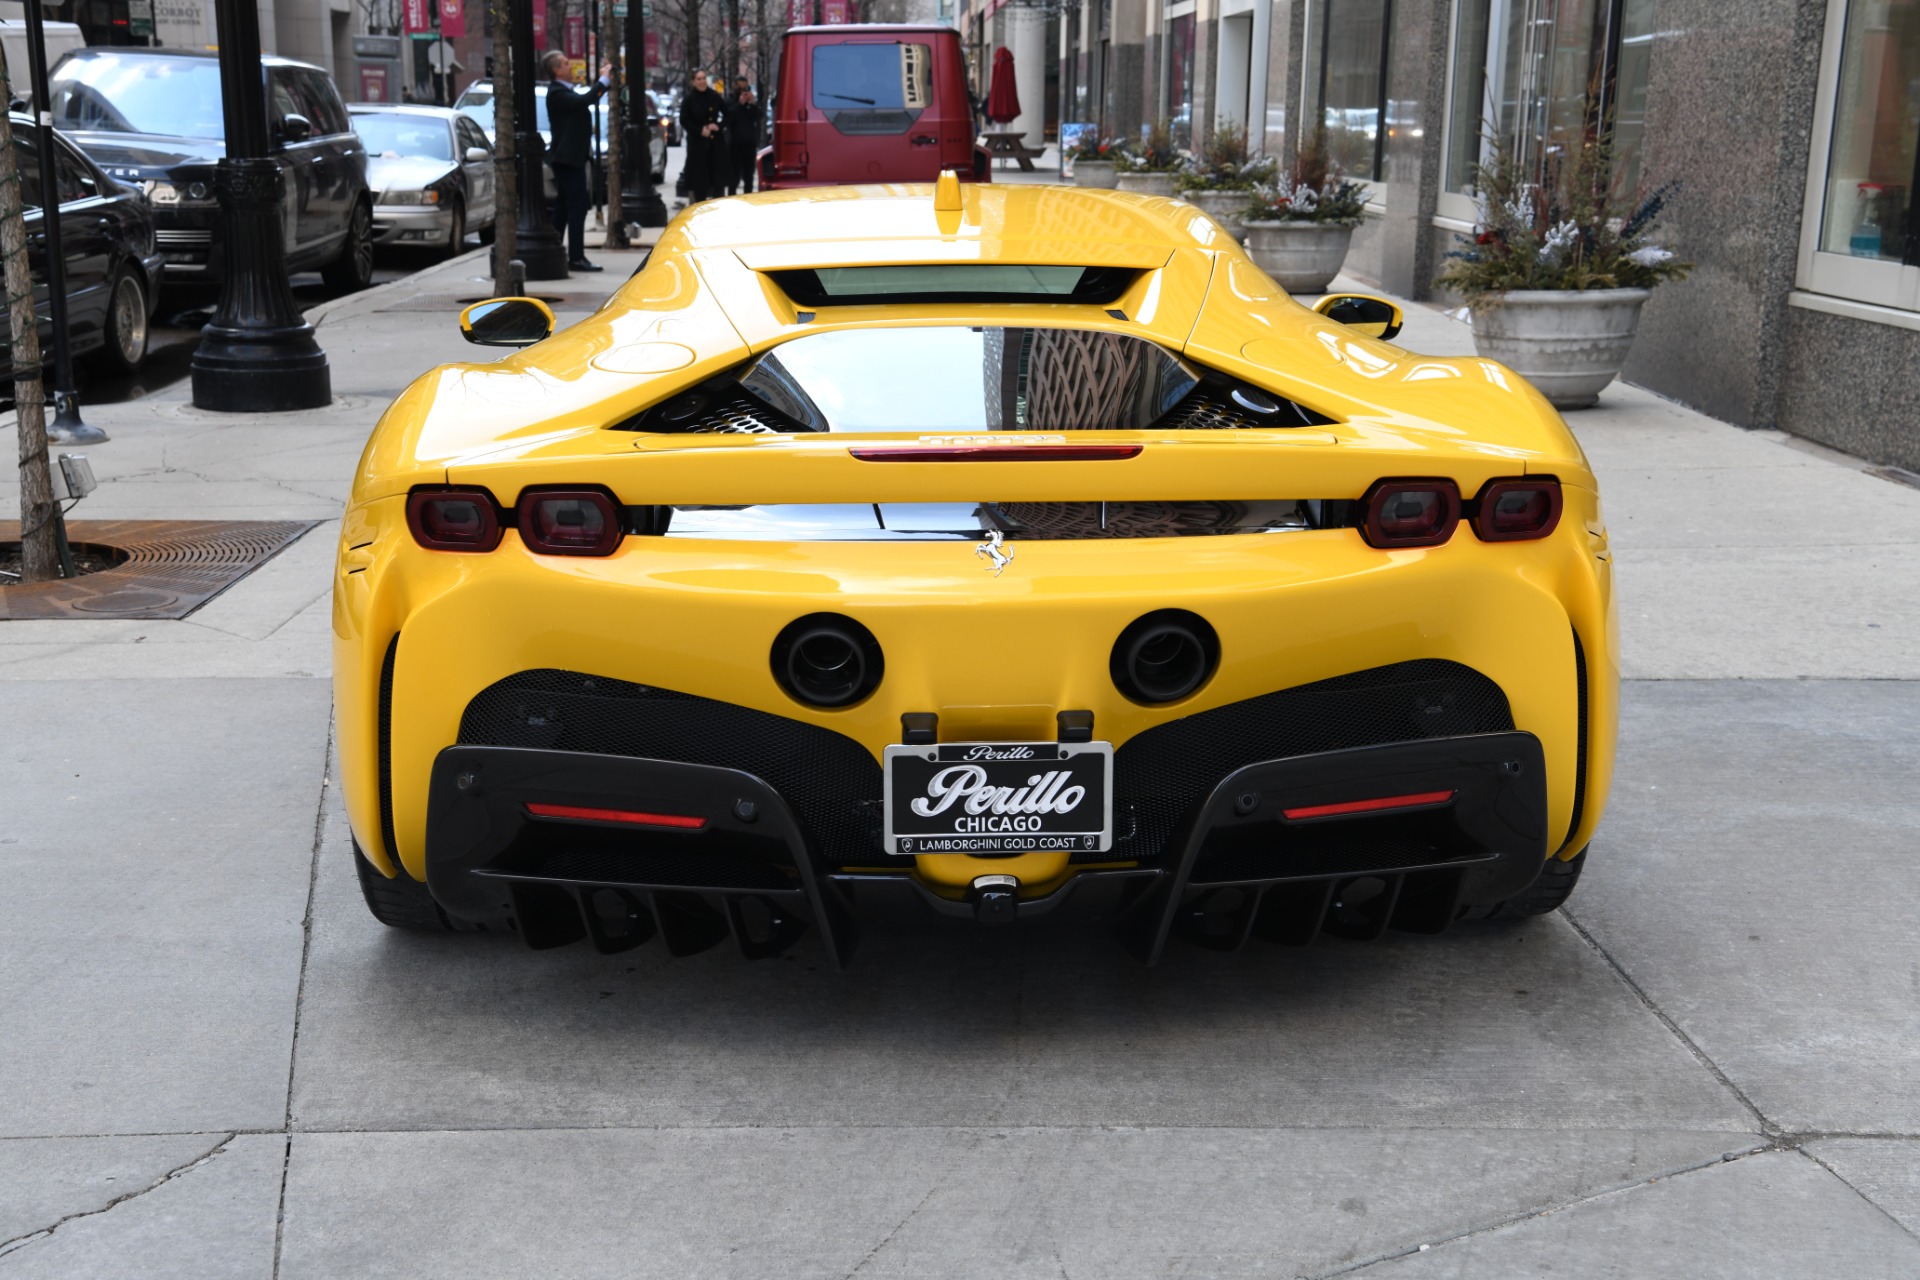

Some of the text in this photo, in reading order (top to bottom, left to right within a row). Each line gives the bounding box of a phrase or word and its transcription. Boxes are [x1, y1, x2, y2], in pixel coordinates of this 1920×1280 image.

[963, 746, 1034, 760] Perillo
[911, 765, 1085, 817] Perillo
[955, 816, 1041, 832] CHICAGO
[919, 838, 1075, 851] LAMBORGHINI GOLD COAST
